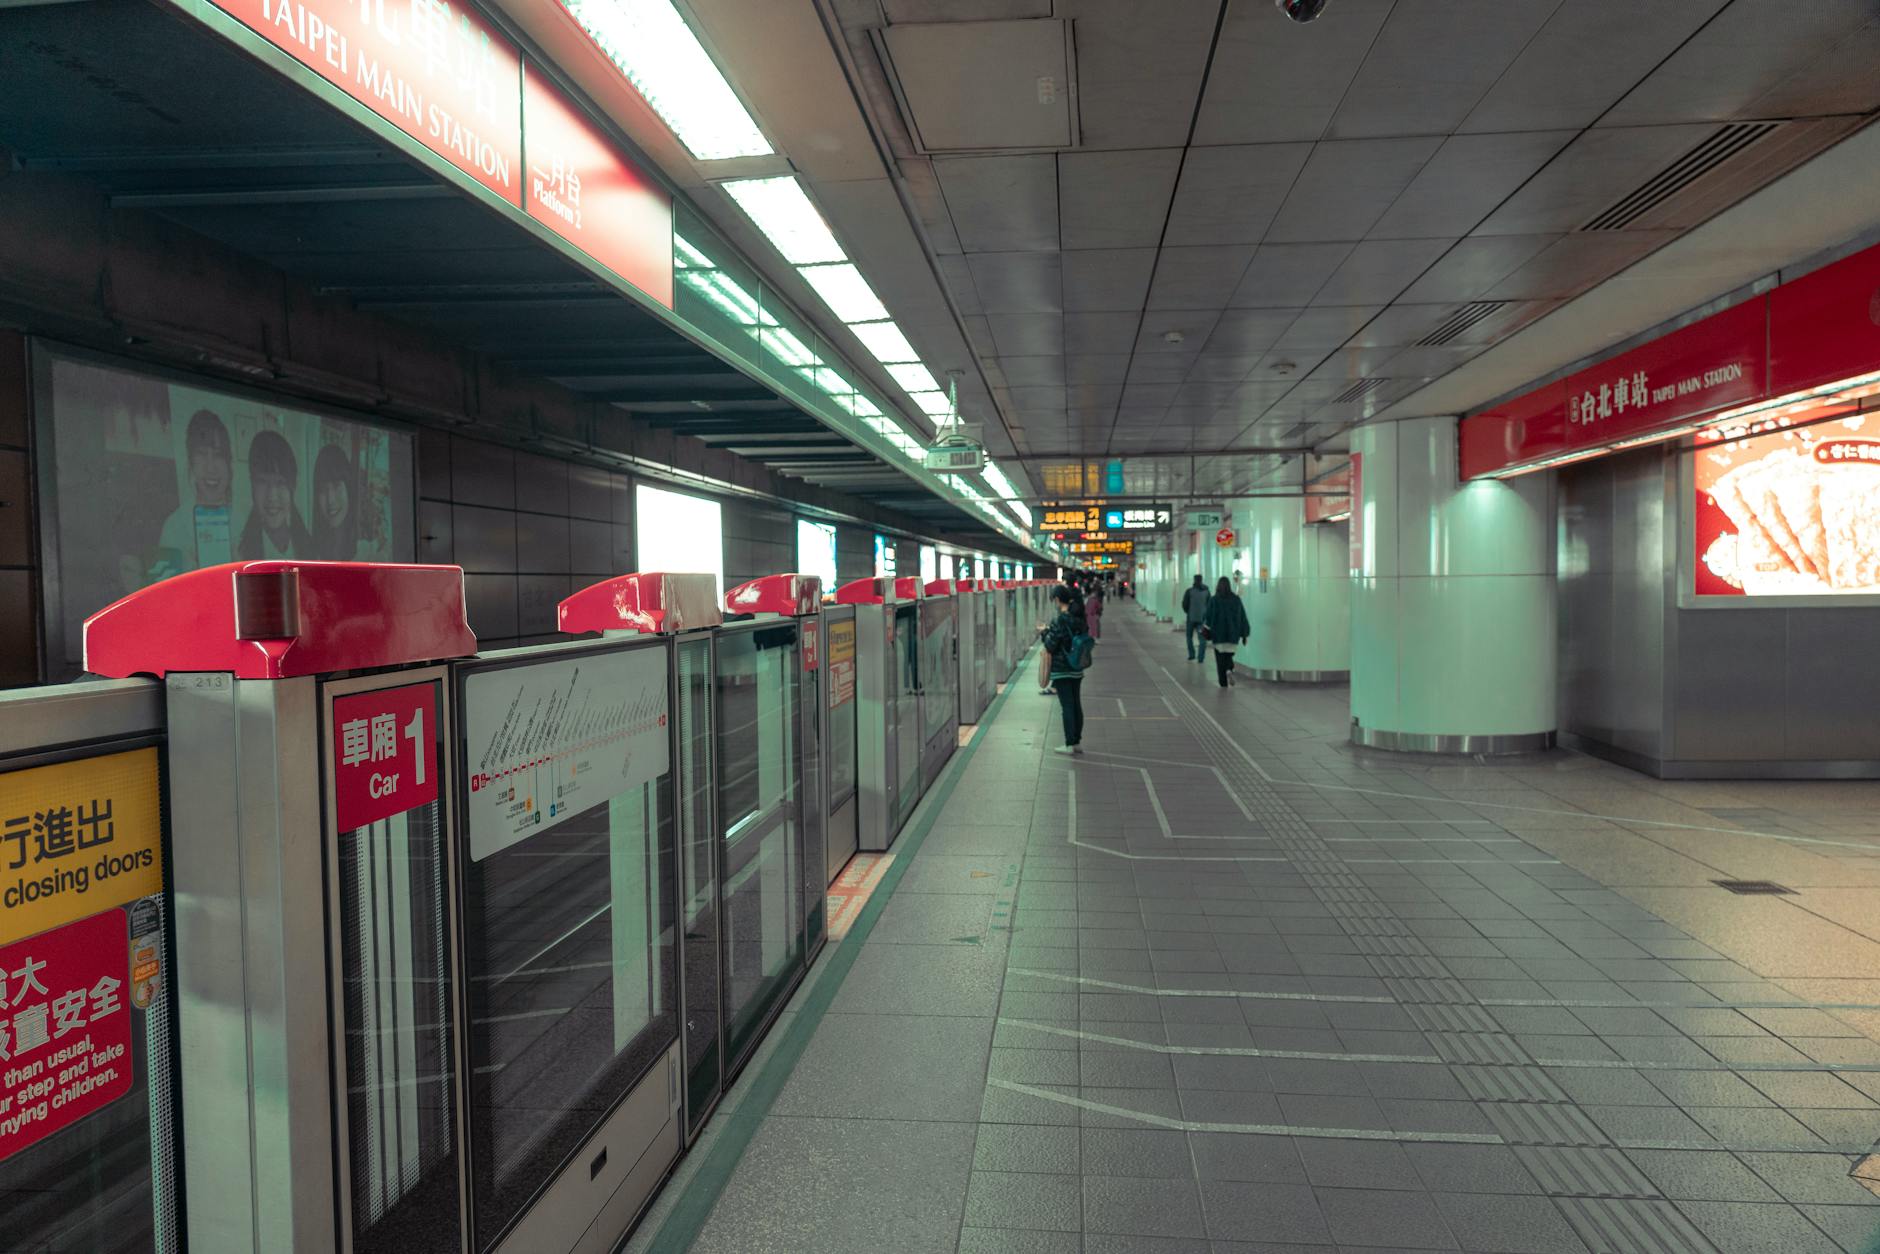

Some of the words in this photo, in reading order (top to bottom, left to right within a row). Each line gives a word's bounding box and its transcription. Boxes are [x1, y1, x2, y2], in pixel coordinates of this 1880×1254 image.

[356, 48, 423, 127] MAIN
[428, 103, 510, 188] STATION
[533, 176, 574, 224] Platform
[575, 208, 582, 229] 2
[1581, 370, 1648, 426] 台北車站
[1652, 384, 1675, 404] TAIPEI
[1678, 375, 1701, 397] MAIN
[1704, 361, 1742, 389] STATION
[196, 677, 222, 688] 213
[342, 713, 397, 767] 車廂
[404, 707, 425, 785] 1
[370, 772, 399, 799] Car
[0, 799, 113, 869] 行進出
[4, 865, 89, 909] closing
[94, 848, 153, 881] doors
[0, 956, 49, 1010] 大
[4, 1060, 44, 1089] than
[47, 1033, 94, 1069] usual,
[17, 1076, 55, 1105] step
[58, 1056, 88, 1085] and
[92, 1043, 124, 1068] take
[52, 1067, 119, 1110] children.
